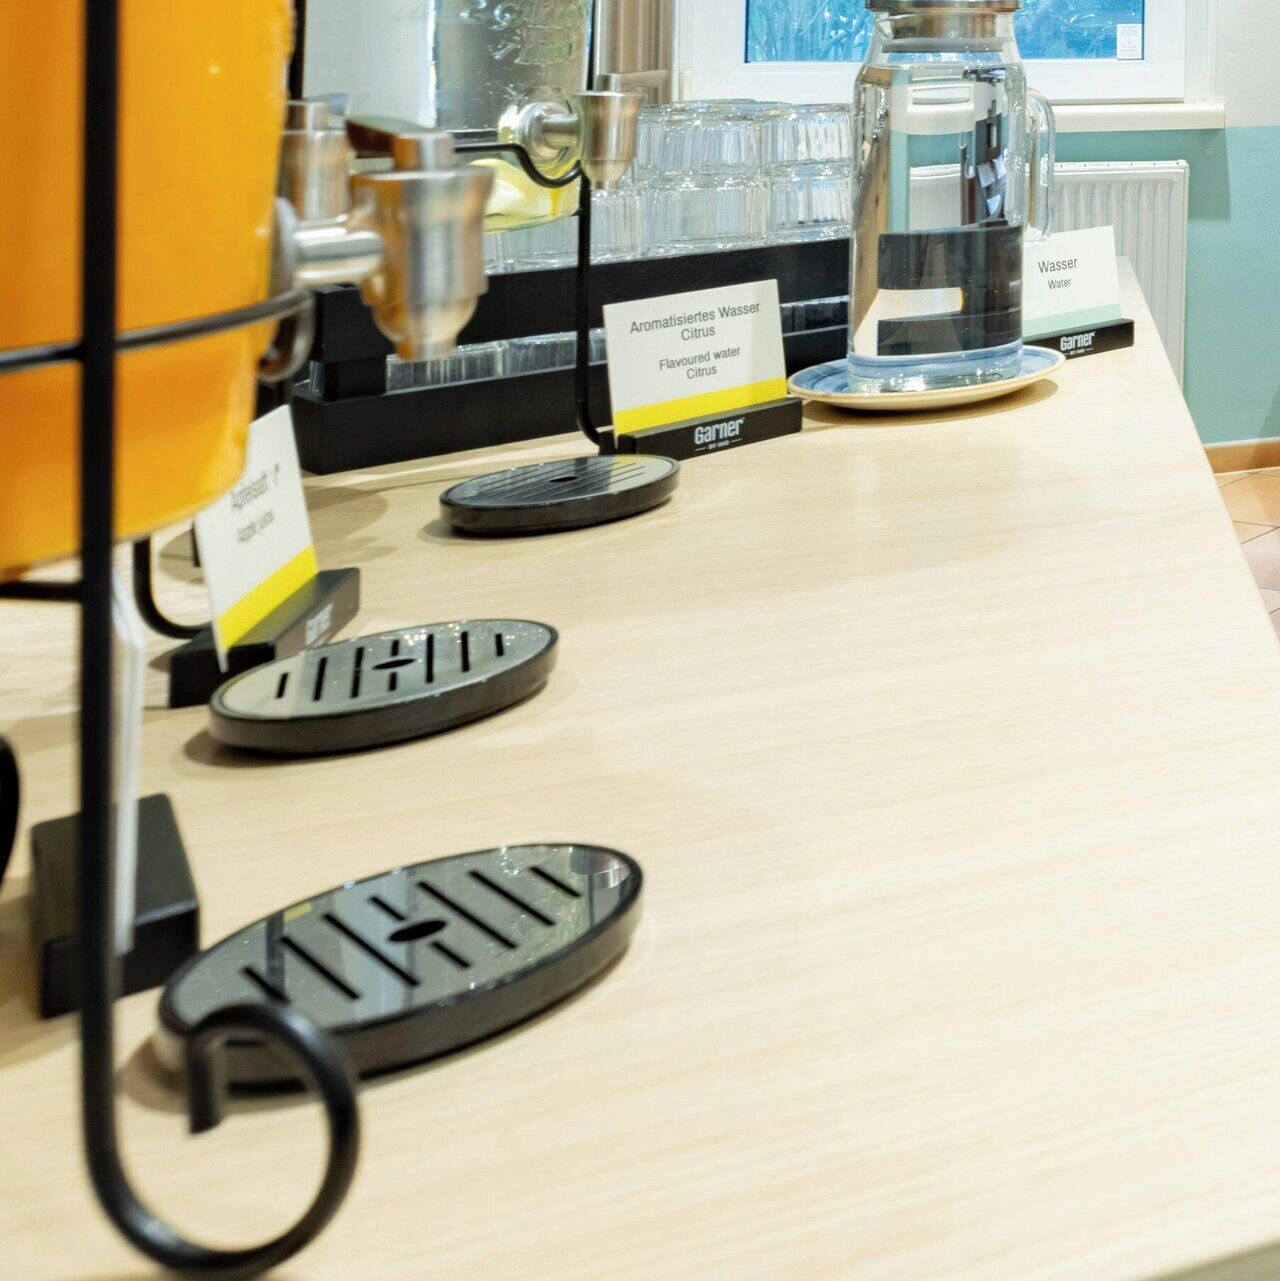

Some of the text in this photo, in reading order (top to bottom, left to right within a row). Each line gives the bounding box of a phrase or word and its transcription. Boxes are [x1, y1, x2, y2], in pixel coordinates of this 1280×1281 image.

[1038, 258, 1078, 274] Wasser
[1048, 278, 1072, 290] Water
[630, 302, 760, 334] Aromatisiertes Wasser
[681, 325, 715, 341] Citrus
[1060, 332, 1095, 351] Garner
[659, 346, 741, 370] Flavoured water
[686, 364, 717, 380] Citrus
[694, 418, 744, 444] Garner
